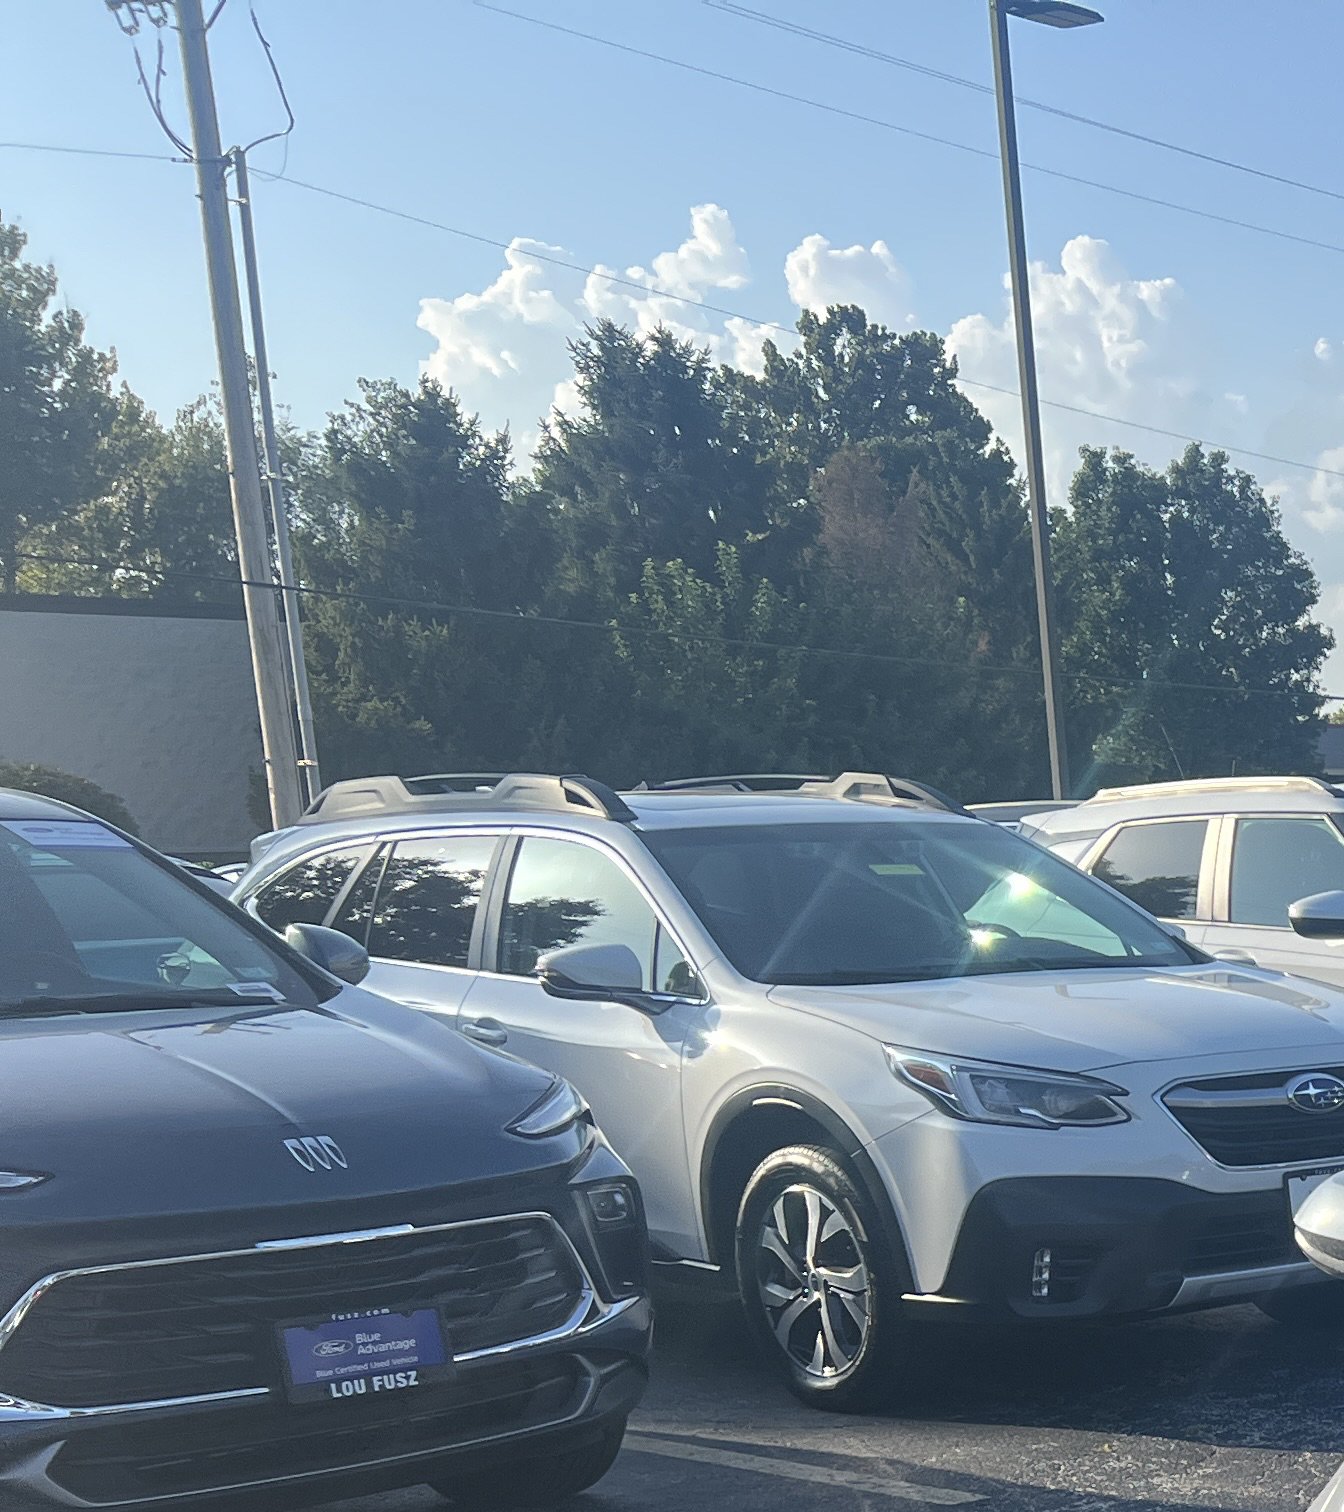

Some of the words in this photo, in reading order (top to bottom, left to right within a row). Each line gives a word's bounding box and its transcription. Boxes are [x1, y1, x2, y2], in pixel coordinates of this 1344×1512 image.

[332, 1308, 390, 1320] fusz.com
[355, 1332, 381, 1343] Blue
[320, 1342, 345, 1354] Ford
[357, 1338, 416, 1354] Advantage
[316, 1370, 334, 1378] Blue
[335, 1363, 368, 1374] Certified
[370, 1360, 390, 1369] Used
[330, 1378, 367, 1398] LOU
[372, 1370, 419, 1392] FUSZ
